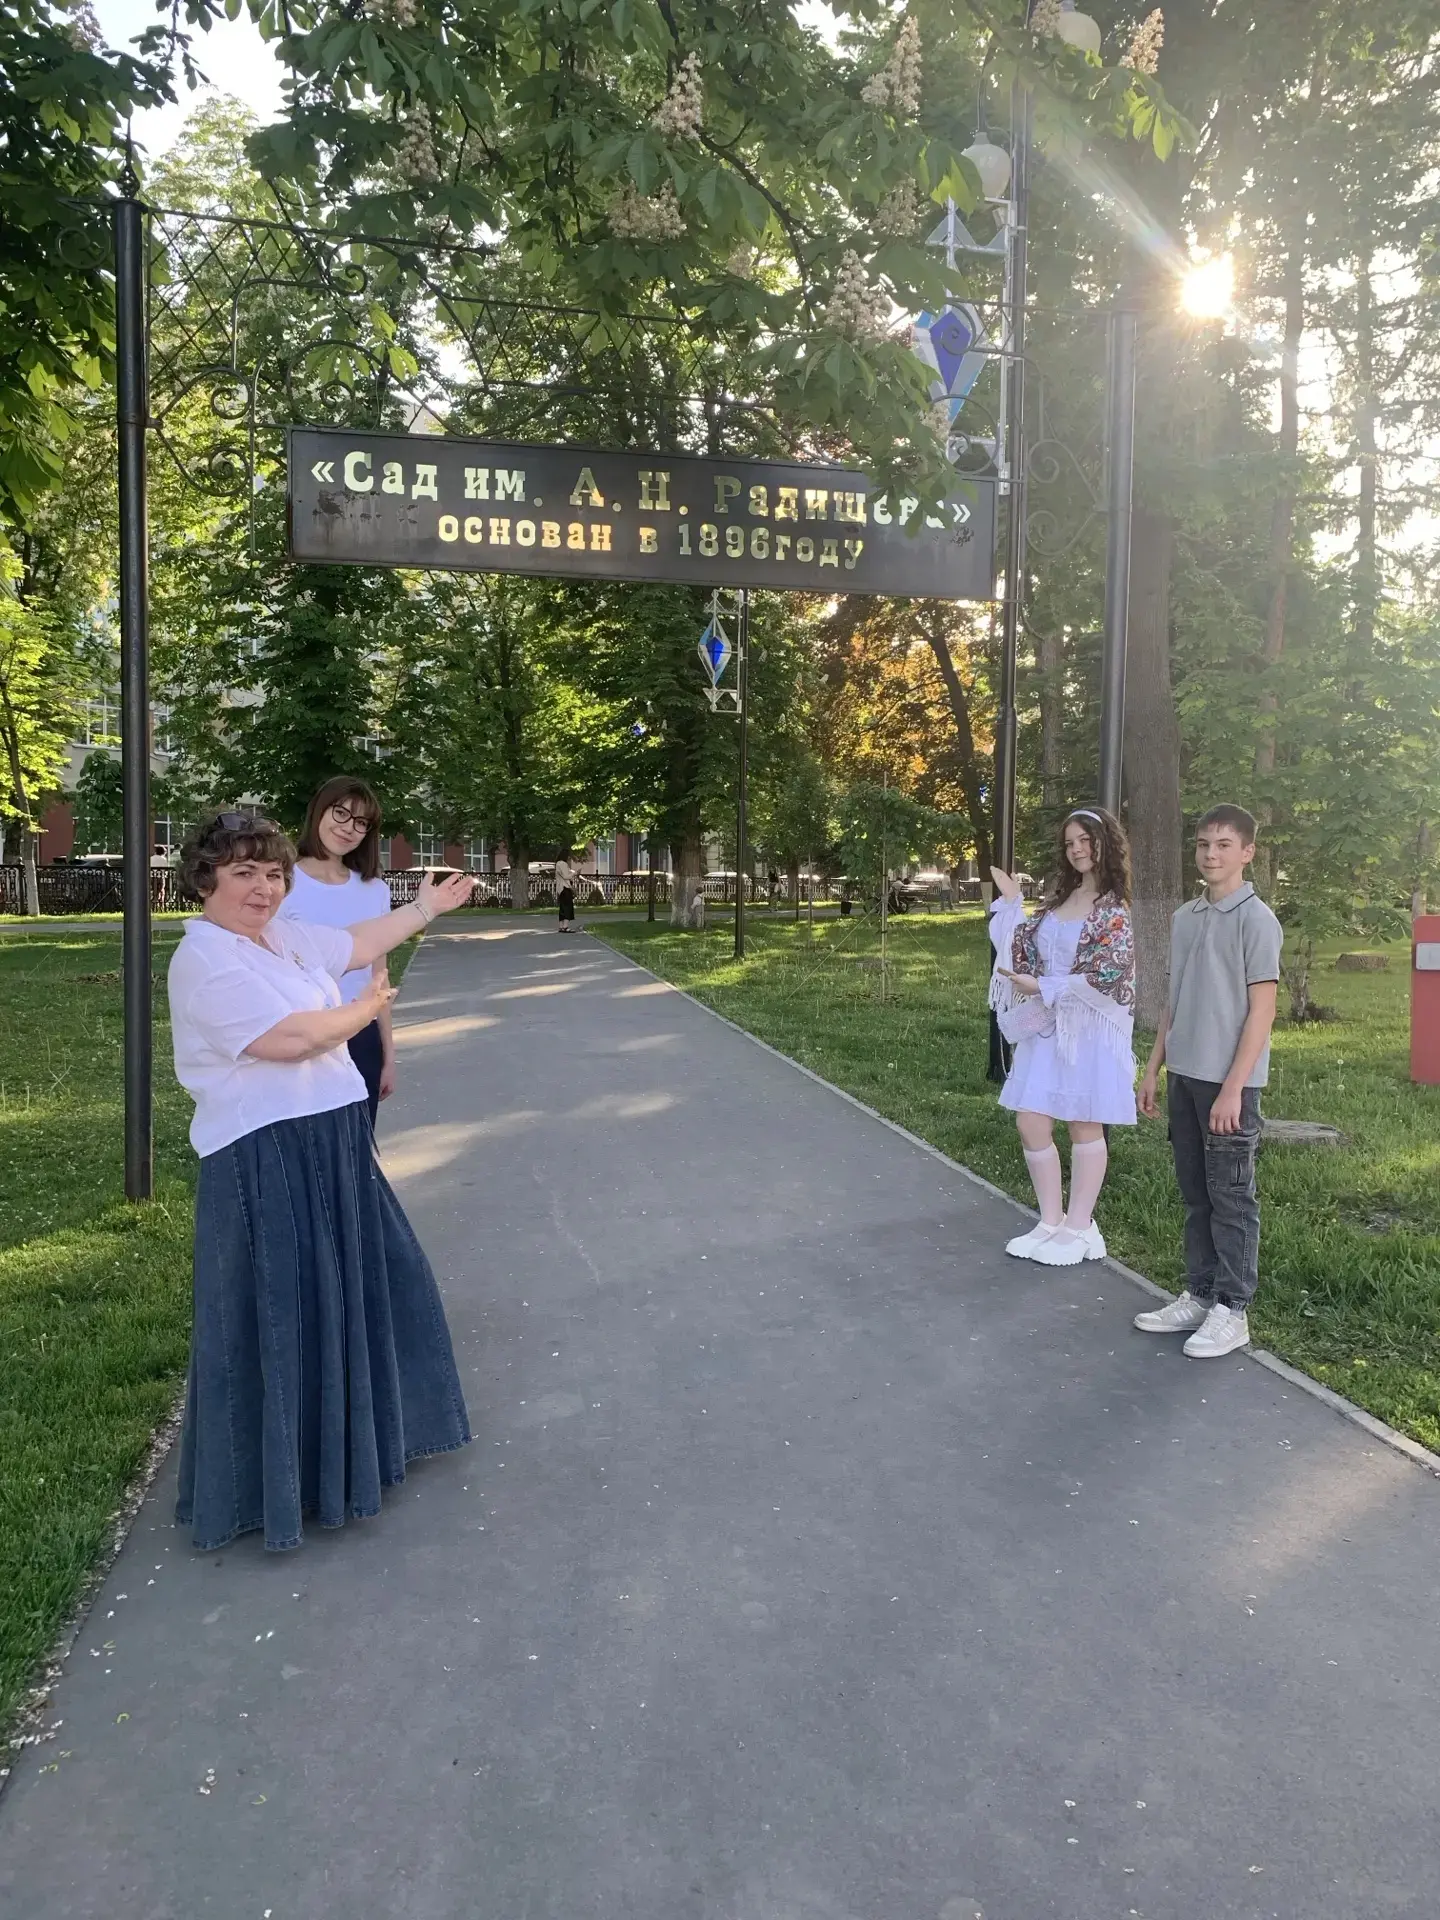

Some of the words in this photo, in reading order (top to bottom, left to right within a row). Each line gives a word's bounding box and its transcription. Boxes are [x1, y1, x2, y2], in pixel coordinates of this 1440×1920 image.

[310, 450, 438, 502] «Сад
[464, 466, 543, 508] им.
[569, 466, 623, 512] А.
[638, 470, 689, 516] Н.
[438, 514, 612, 552] основан
[639, 526, 659, 554] в
[678, 523, 864, 570] 1896году
